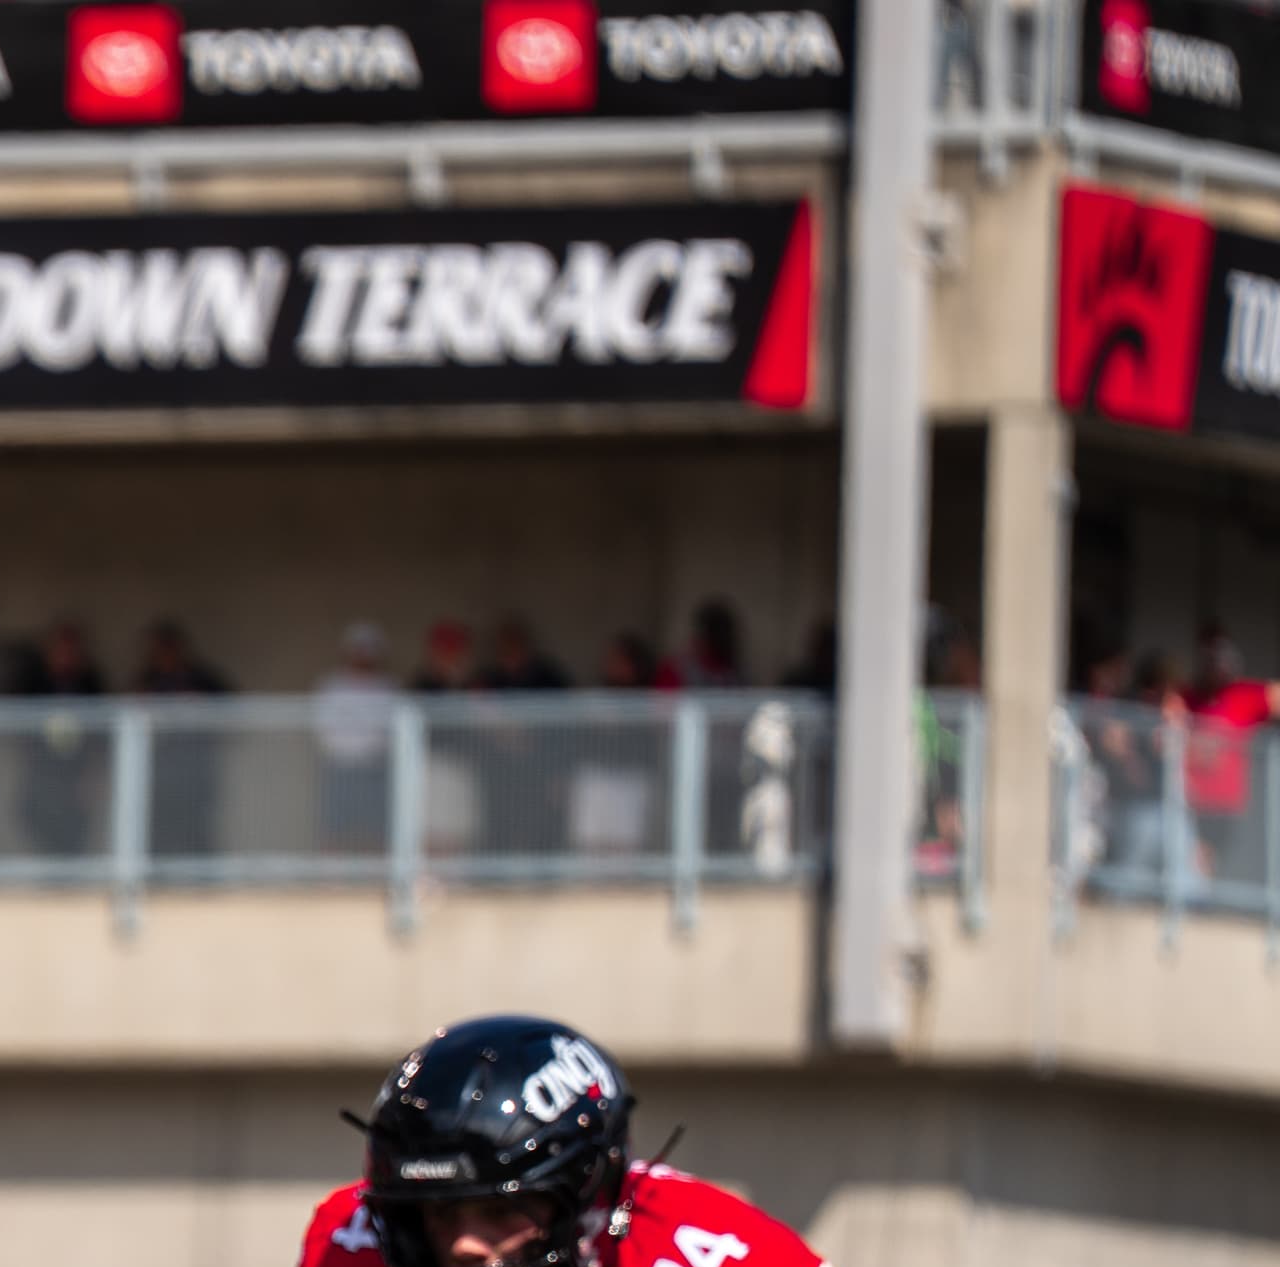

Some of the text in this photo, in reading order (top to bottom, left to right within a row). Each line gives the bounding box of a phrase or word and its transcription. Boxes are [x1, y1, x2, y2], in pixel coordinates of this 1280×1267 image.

[181, 26, 422, 94] TOYOTA
[599, 11, 842, 81] TOYOTA
[296, 239, 753, 366] TERRACE
